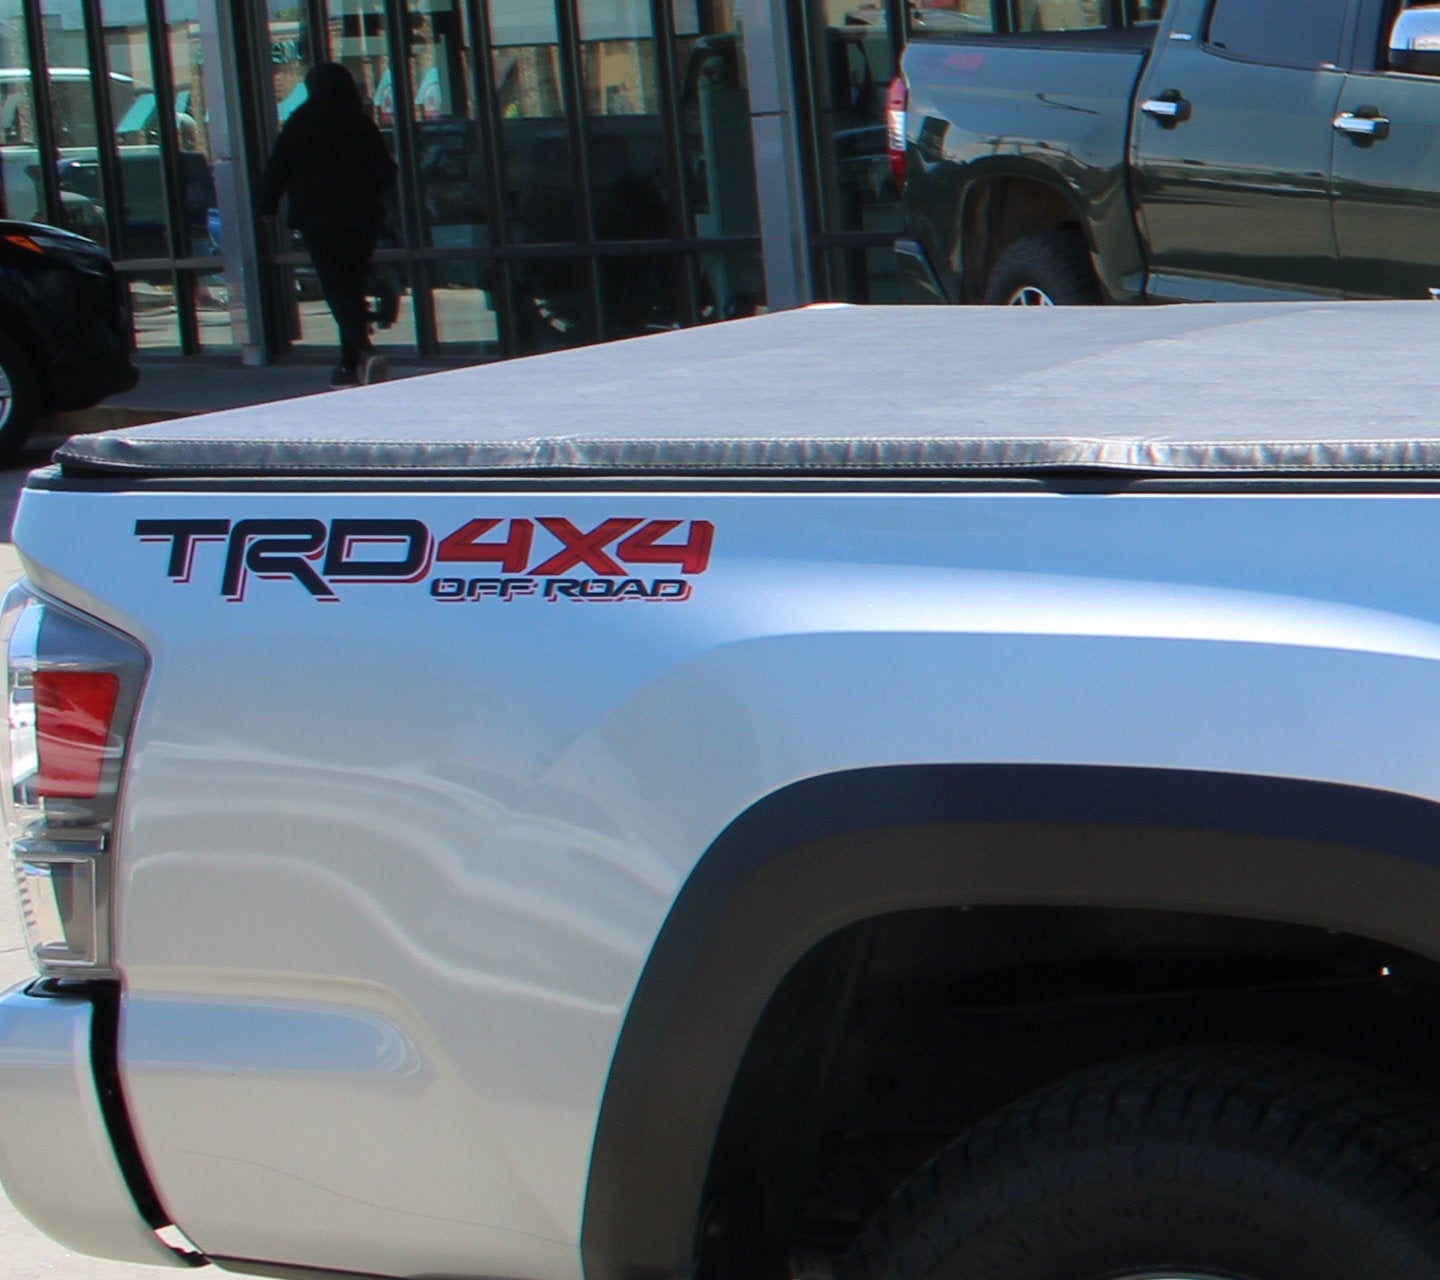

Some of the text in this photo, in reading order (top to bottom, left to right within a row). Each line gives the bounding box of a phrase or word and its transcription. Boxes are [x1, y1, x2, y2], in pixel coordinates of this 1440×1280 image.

[133, 517, 716, 603] TRD 4X4
[429, 577, 693, 603] OFF ROAD
